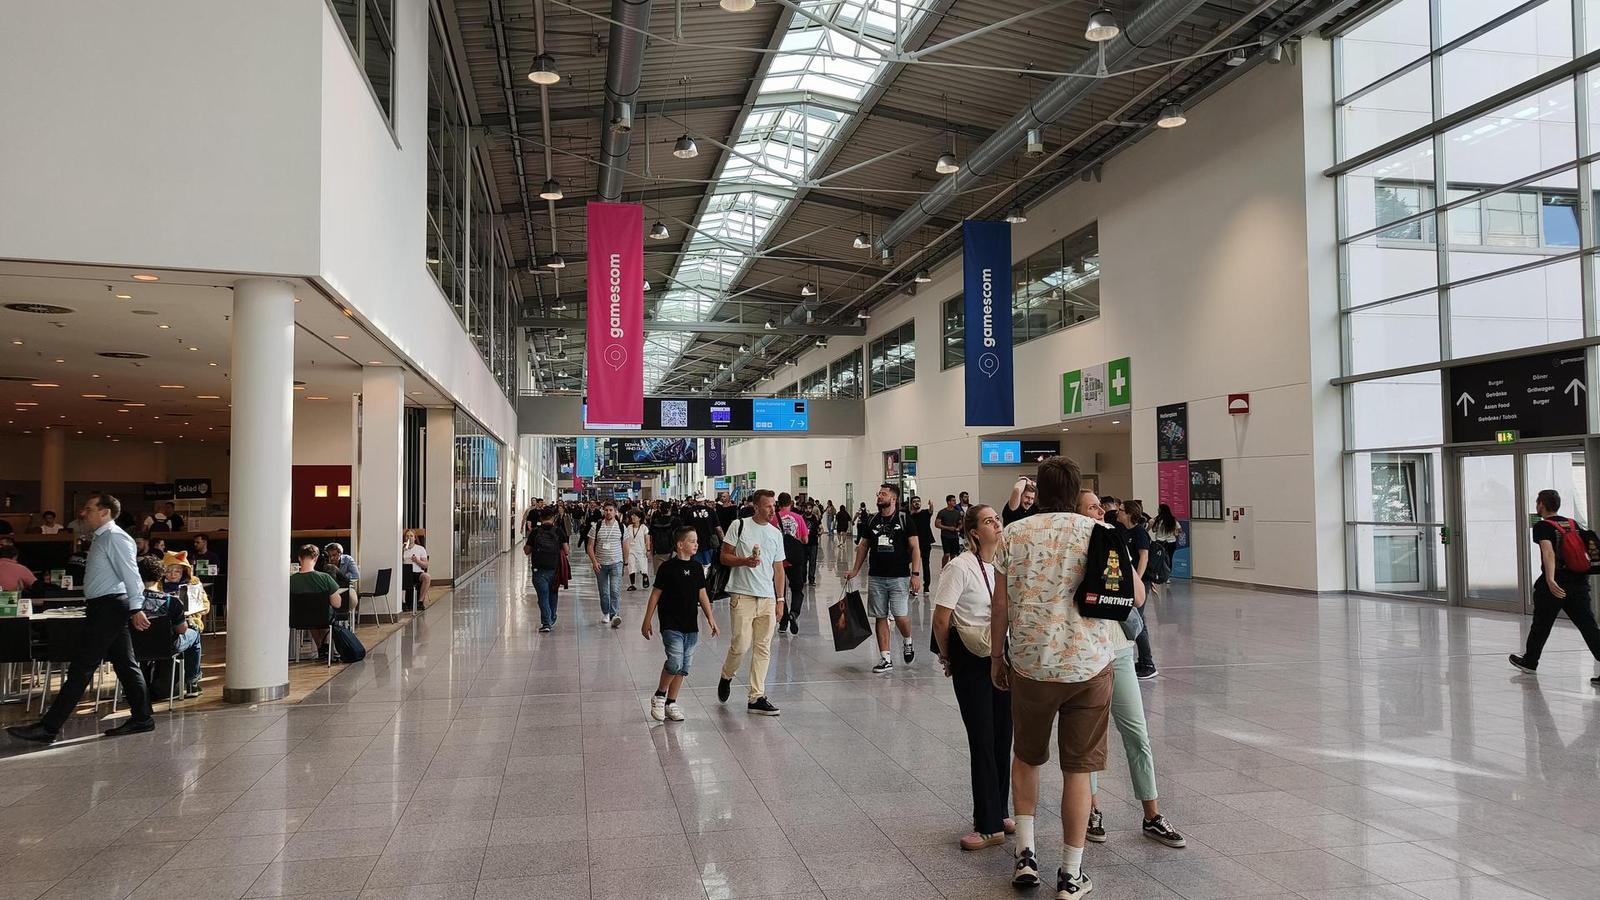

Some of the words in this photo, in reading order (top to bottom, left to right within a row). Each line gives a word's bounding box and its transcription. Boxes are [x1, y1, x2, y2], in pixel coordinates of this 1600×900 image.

[610, 253, 624, 338] gamescom
[982, 268, 996, 347] gamescom
[1070, 381, 1080, 413] 7
[790, 419, 796, 428] 7
[178, 484, 197, 493] Salad
[1098, 595, 1134, 607] FORTNITE
